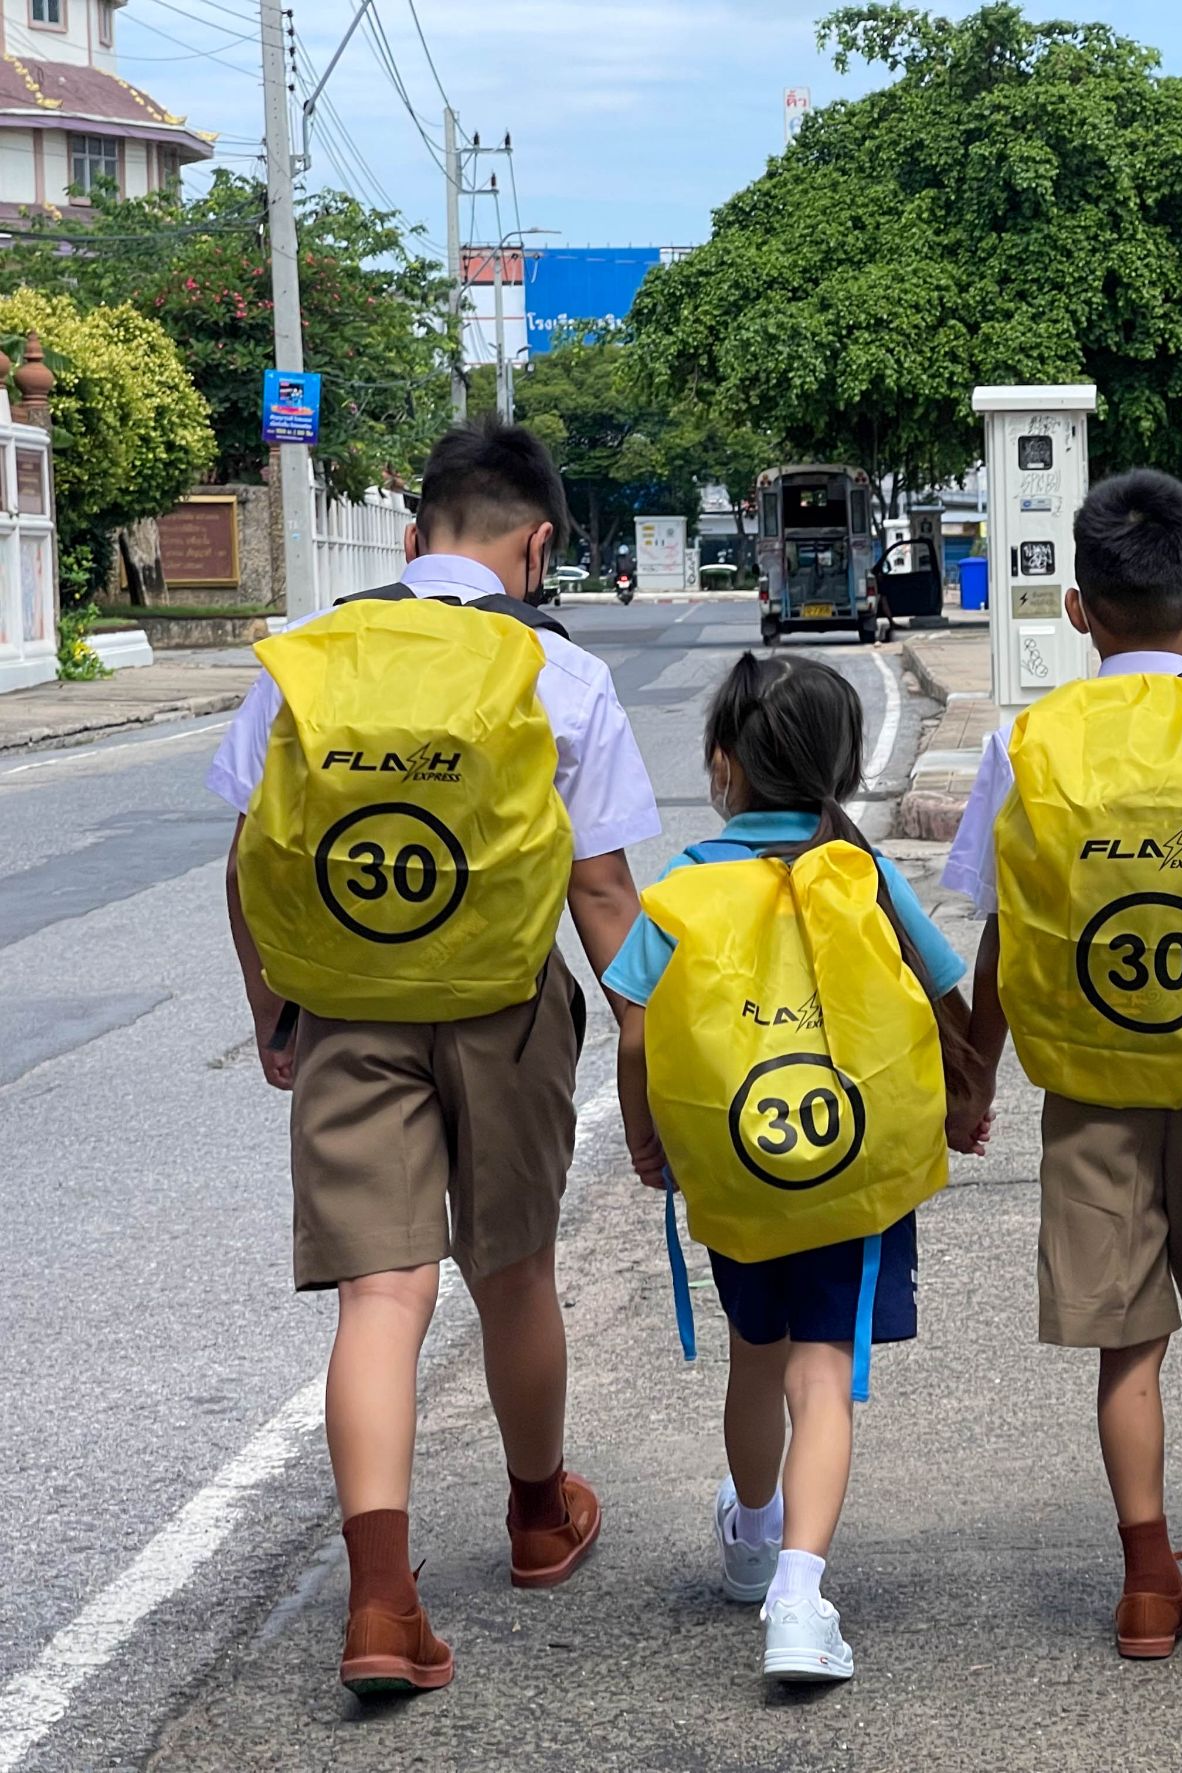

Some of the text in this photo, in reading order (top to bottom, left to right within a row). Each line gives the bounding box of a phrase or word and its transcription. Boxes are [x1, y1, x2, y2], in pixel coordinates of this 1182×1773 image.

[412, 771, 462, 783] EXPRESS
[346, 841, 437, 902] 30
[757, 1088, 840, 1155] 30
